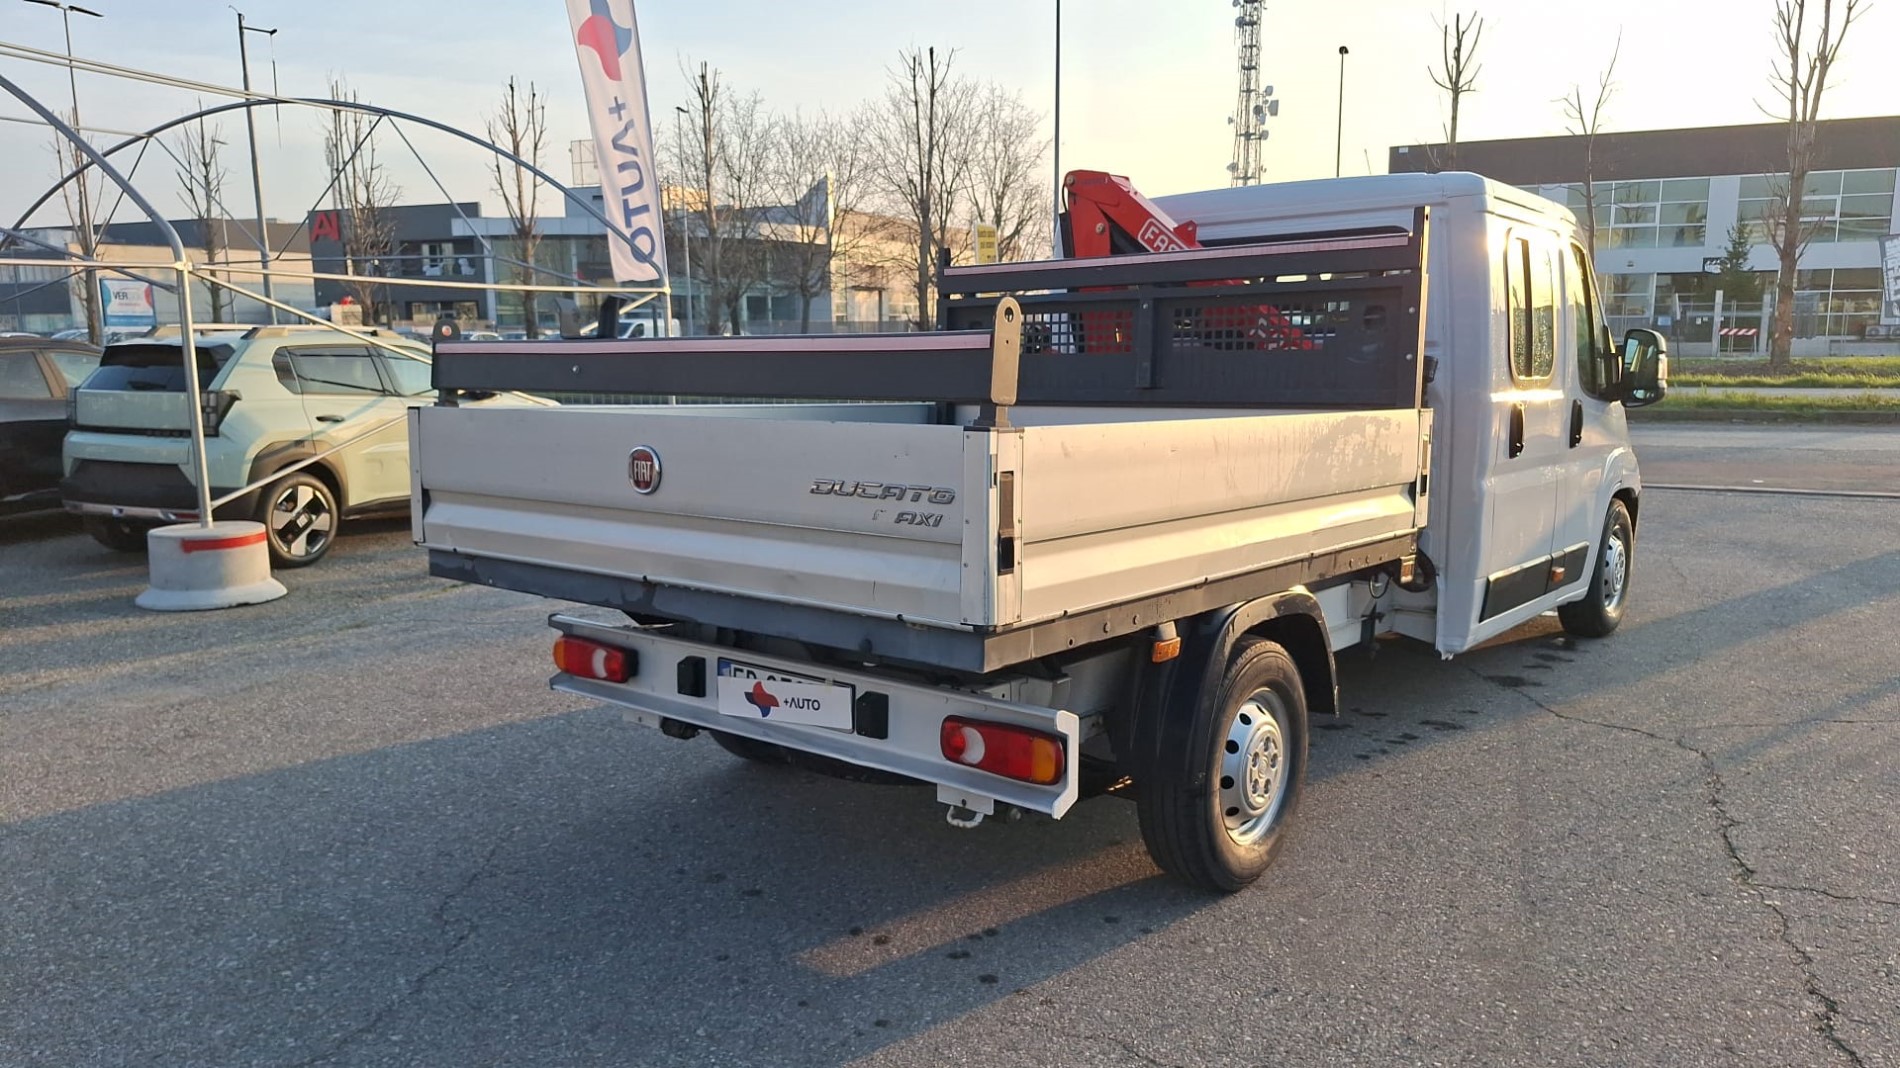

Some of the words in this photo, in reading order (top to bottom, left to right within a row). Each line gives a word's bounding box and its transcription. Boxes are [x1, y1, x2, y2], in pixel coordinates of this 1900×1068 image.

[634, 460, 652, 482] FIAT
[809, 478, 956, 505] DUCATO
[783, 697, 821, 711] +AUTO
